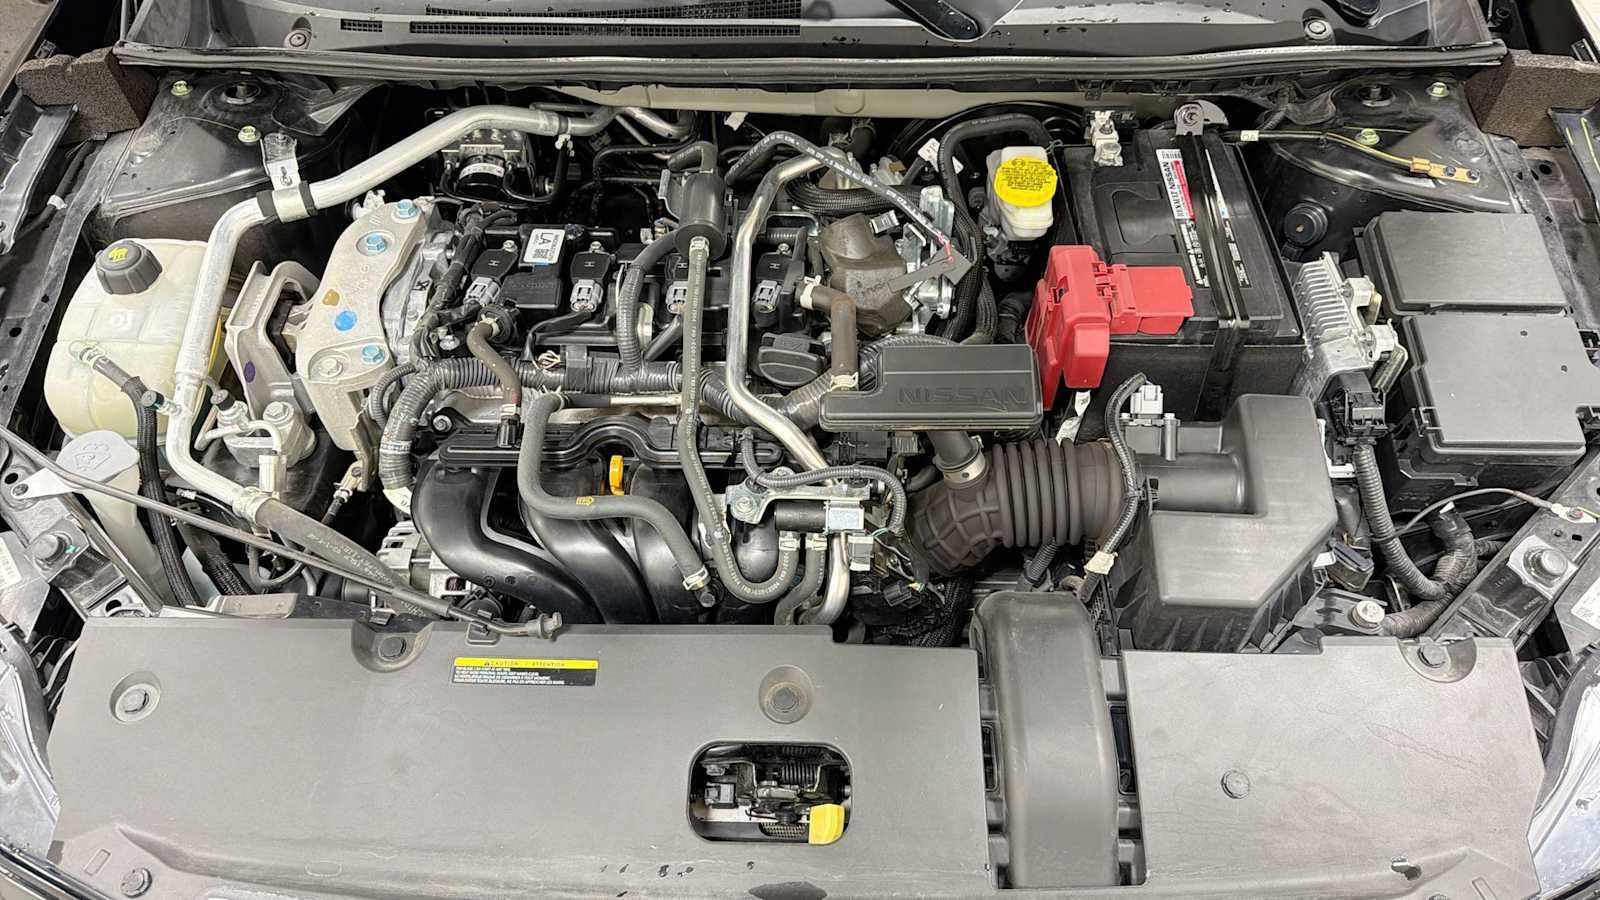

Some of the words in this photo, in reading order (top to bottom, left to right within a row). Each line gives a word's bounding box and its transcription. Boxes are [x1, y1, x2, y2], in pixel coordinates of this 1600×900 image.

[1161, 161, 1176, 190] NISSAN
[1170, 191, 1184, 217] RENAULT
[897, 384, 1028, 404] NISSAN
[490, 659, 519, 667] CAUTION
[531, 660, 566, 668] ATTENTION
